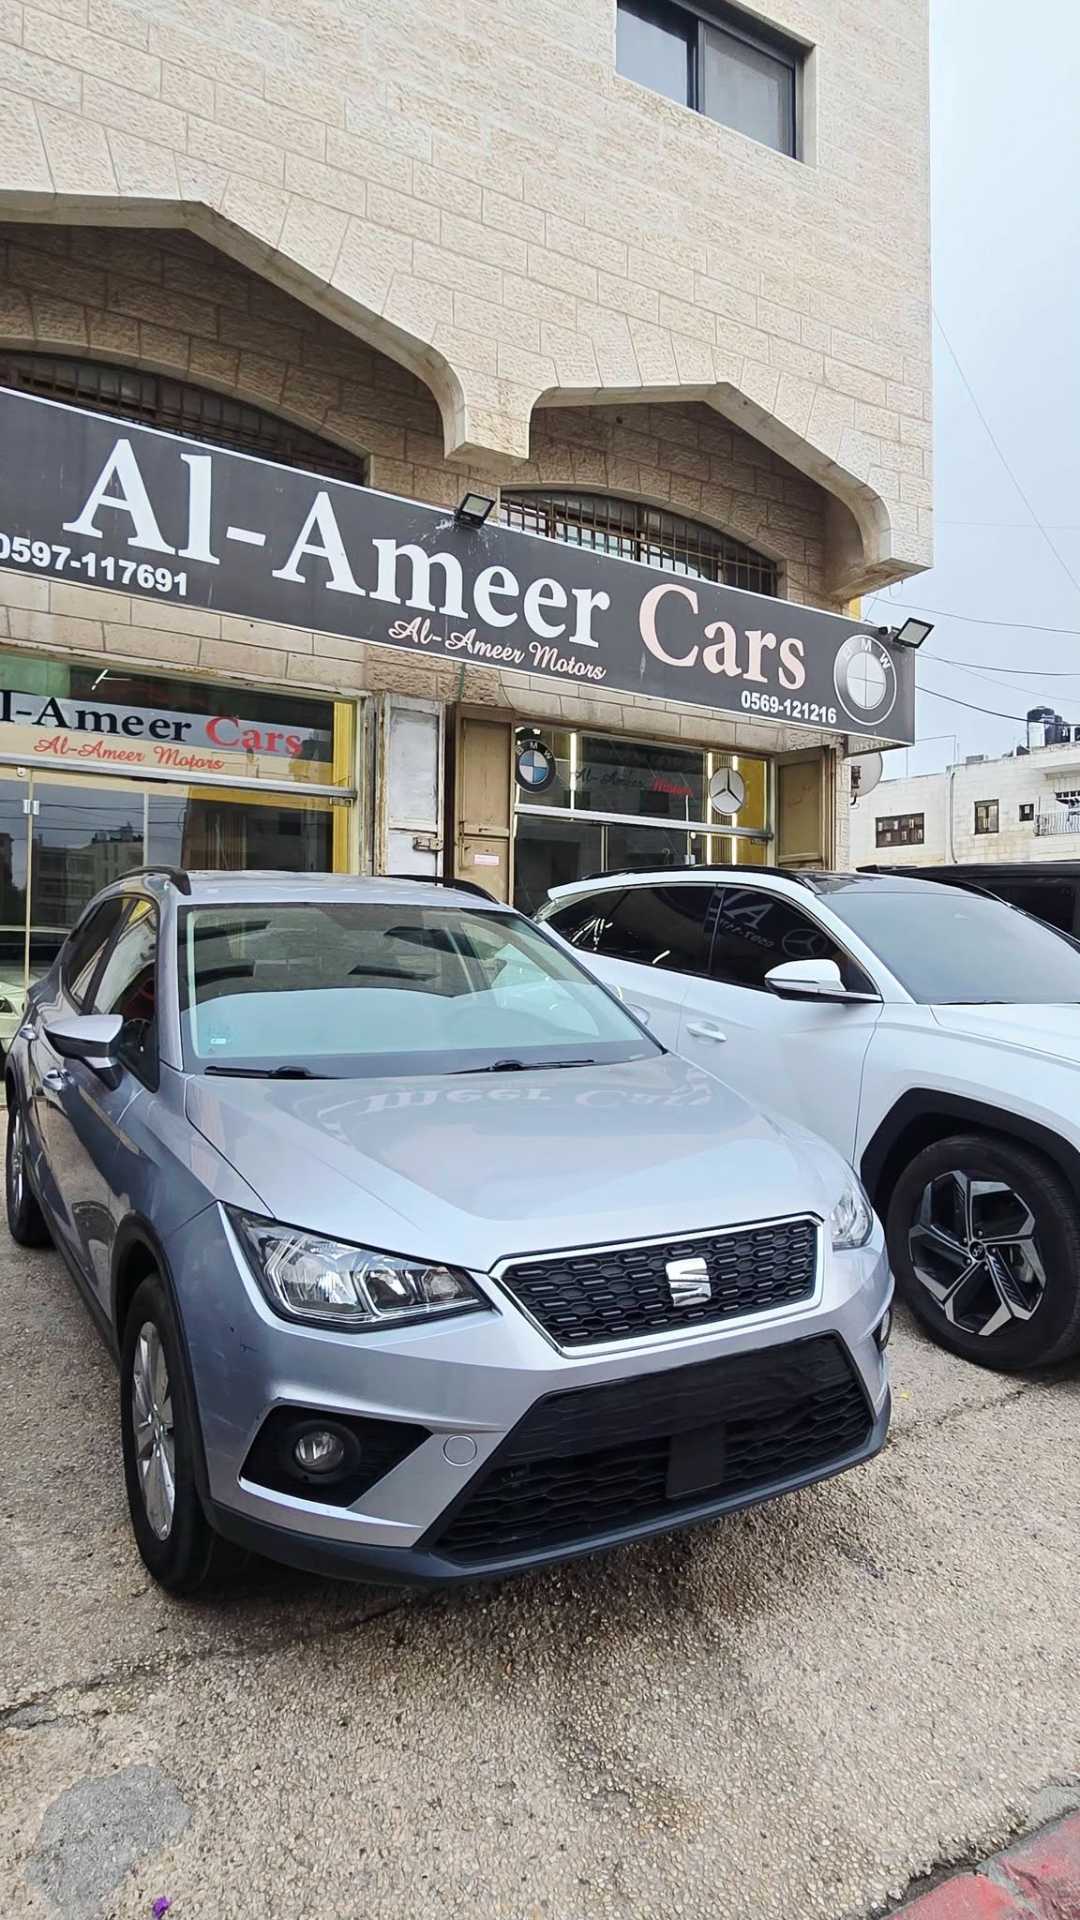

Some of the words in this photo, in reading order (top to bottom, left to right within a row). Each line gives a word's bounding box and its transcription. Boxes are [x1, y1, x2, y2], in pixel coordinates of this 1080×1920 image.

[0, 532, 187, 596] 0597-117691
[62, 438, 610, 648] Al-Ameer
[638, 583, 806, 690] Cars
[388, 616, 524, 666] Al-Ameer
[528, 642, 607, 681] Motors
[740, 690, 838, 724] 0569-121216
[33, 735, 145, 763] Al-Ameer
[153, 746, 225, 770] Motors
[205, 714, 303, 755] Cars
